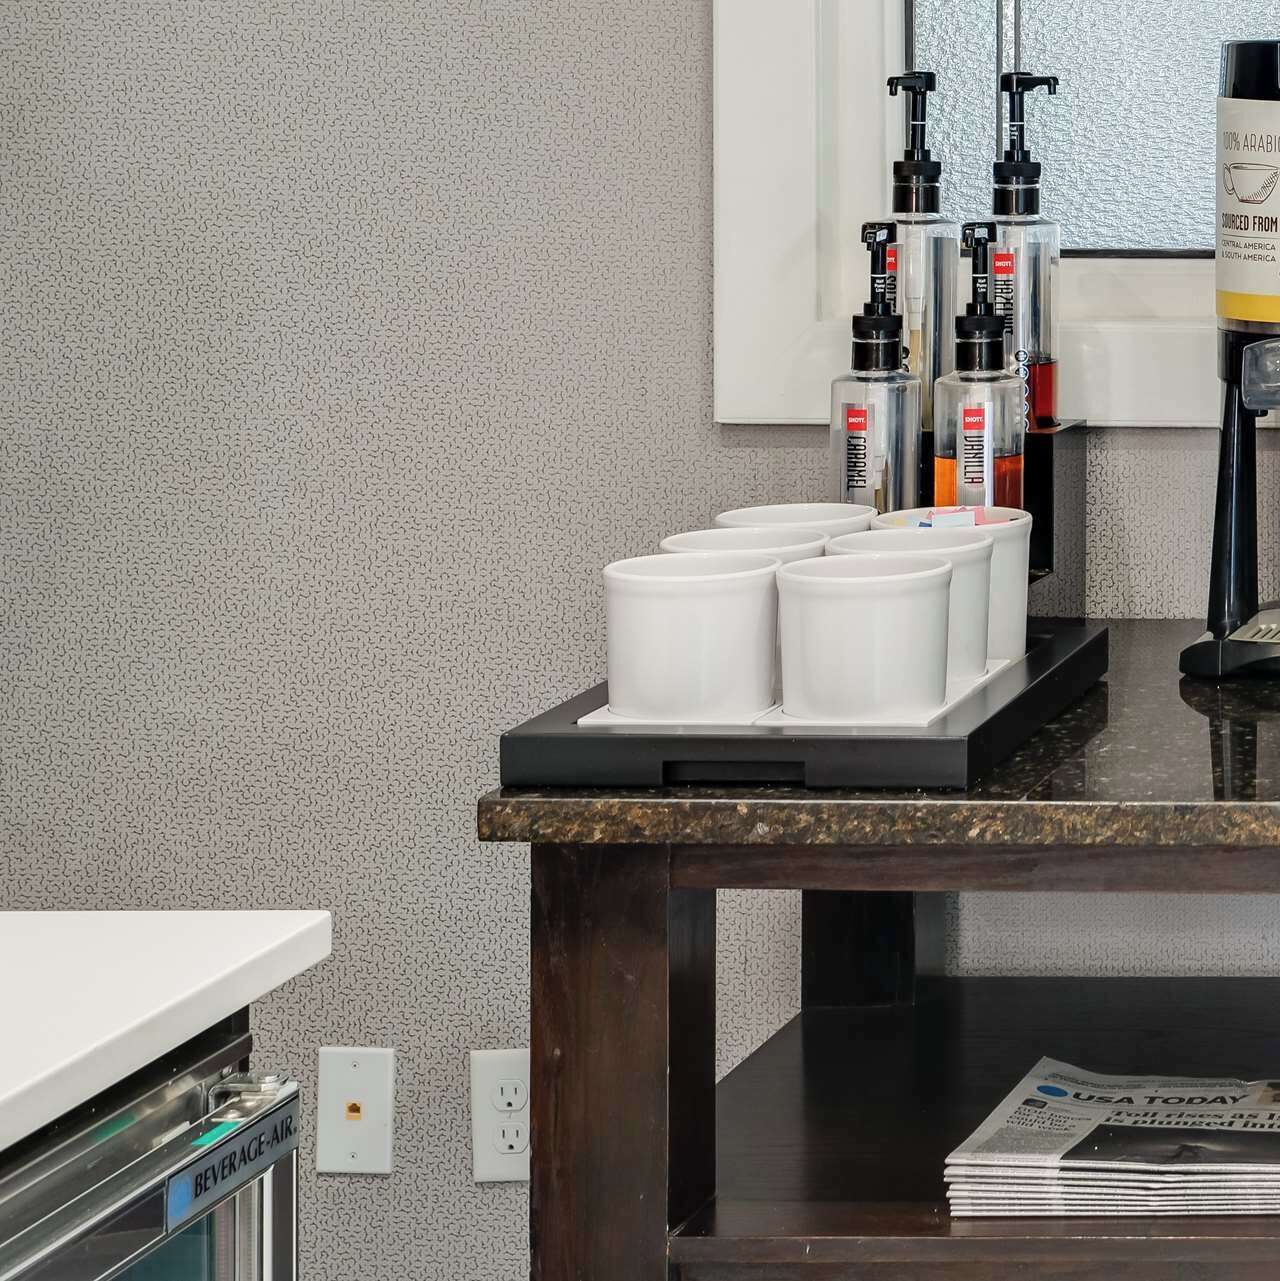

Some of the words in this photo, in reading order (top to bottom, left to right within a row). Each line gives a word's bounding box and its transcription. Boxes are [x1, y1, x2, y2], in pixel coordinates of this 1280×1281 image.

[1223, 131, 1240, 151] 100%
[1222, 212, 1249, 232] SOURCED
[1252, 216, 1278, 232] FROM
[1222, 239, 1242, 250] CENTRAL
[1243, 242, 1276, 251] AMERICA
[1225, 252, 1242, 261] SOUTH
[1243, 254, 1276, 263] AMERICA
[847, 435, 867, 491] CARAMEL
[964, 435, 985, 484] VANILLA
[1072, 1091, 1135, 1105] USA
[1143, 1095, 1249, 1105] TODAY
[1112, 1110, 1159, 1118] Toll
[1230, 1112, 1259, 1120] as
[1131, 1118, 1234, 1127] plunged
